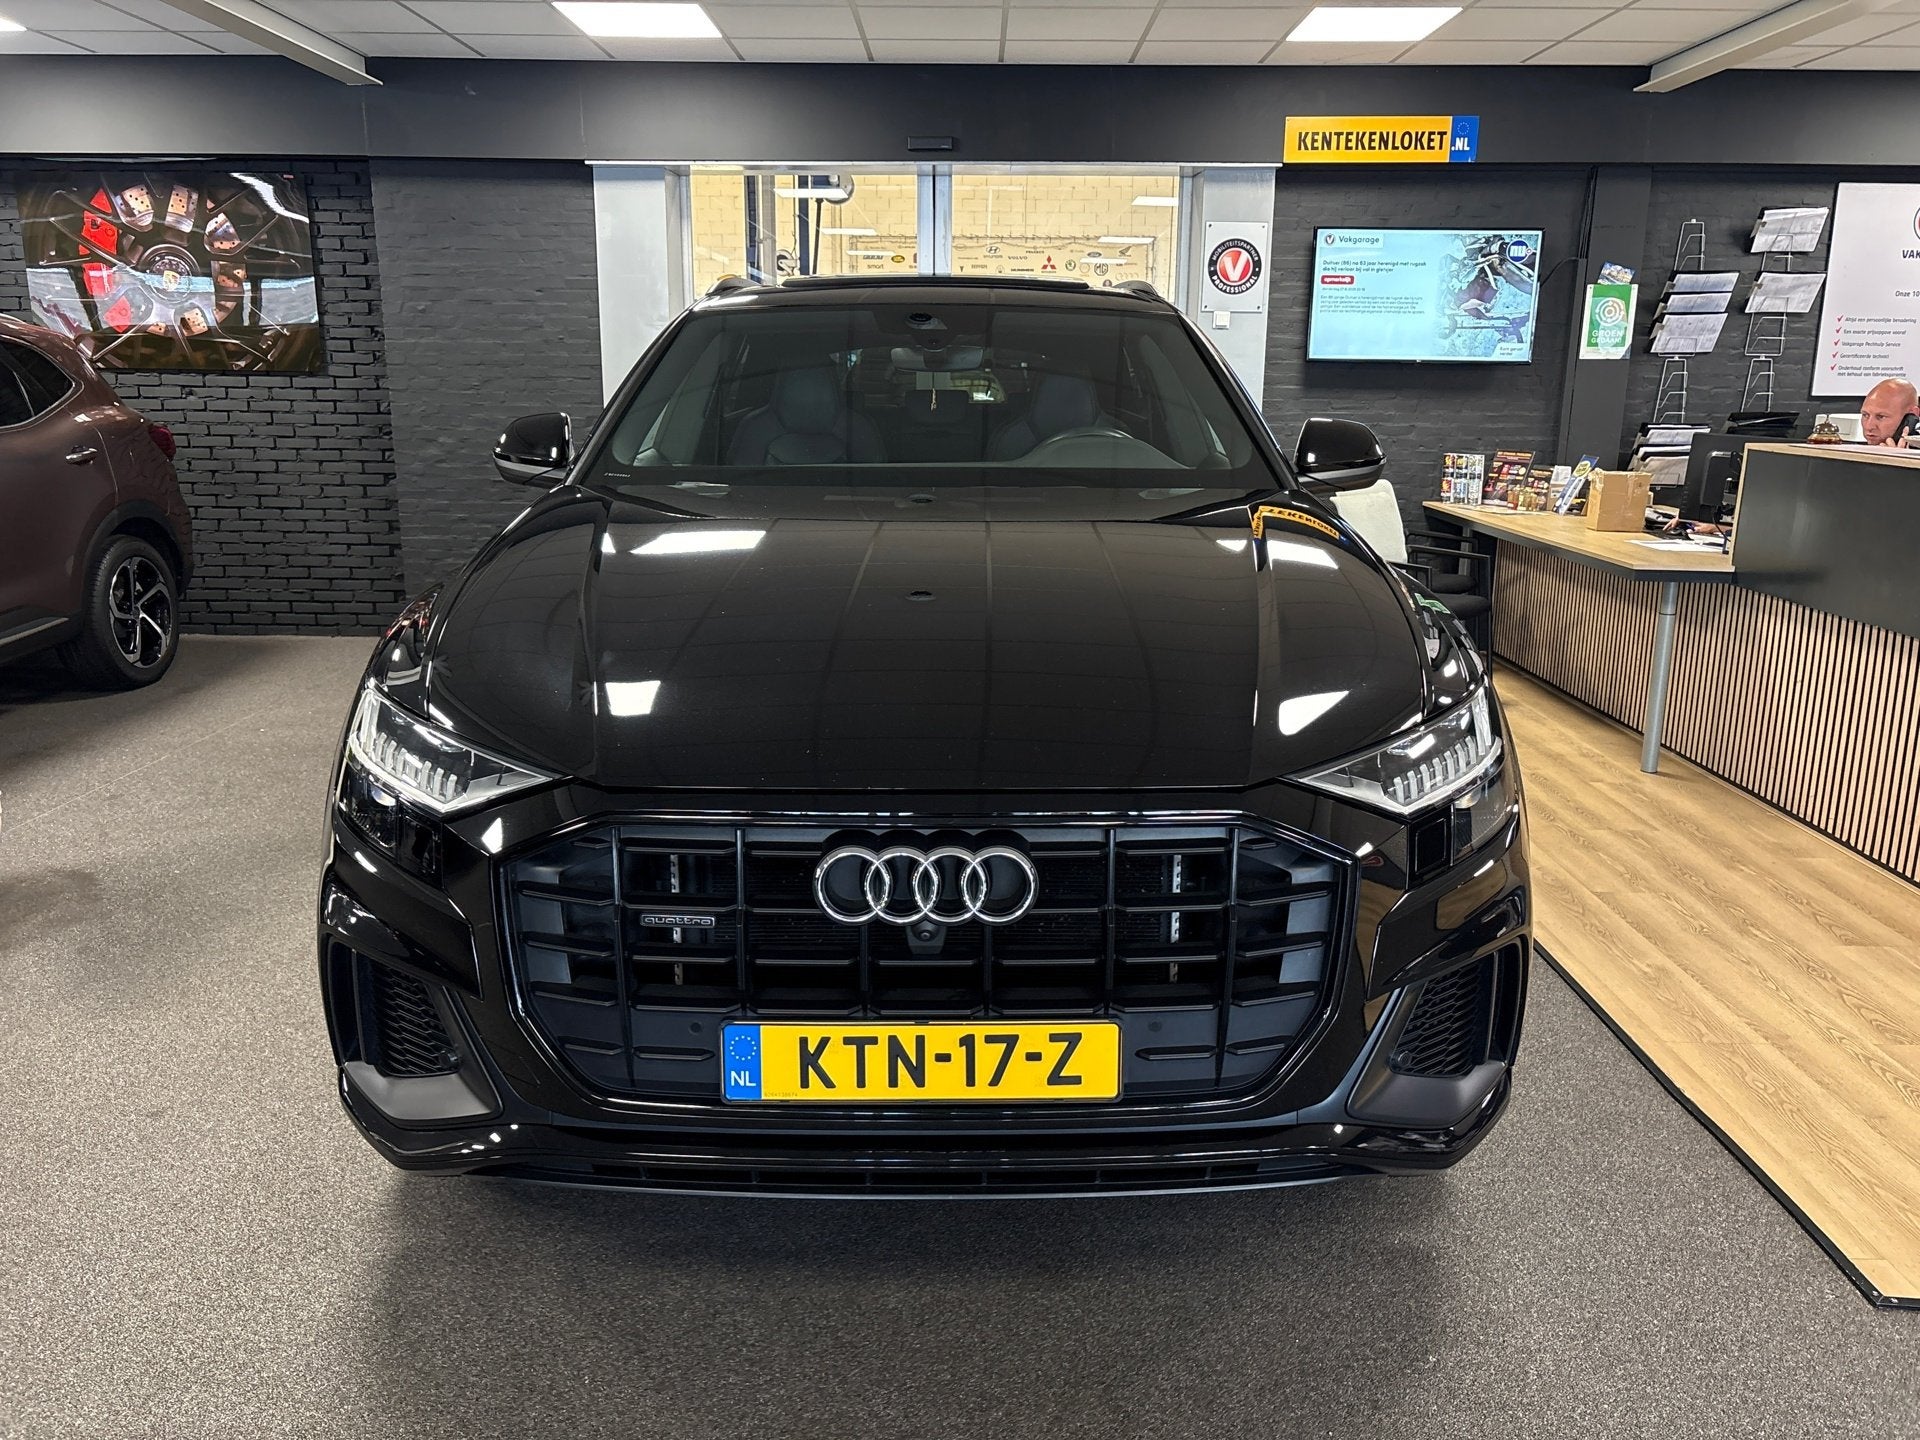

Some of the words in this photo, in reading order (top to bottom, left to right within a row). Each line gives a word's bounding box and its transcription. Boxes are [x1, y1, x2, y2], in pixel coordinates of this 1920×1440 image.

[1298, 131, 1447, 151] KENTEKENLOKET
[1451, 137, 1470, 151] .NL
[1339, 235, 1380, 245] Vakgarage
[1212, 240, 1259, 261] MOBILITEITSPARTNER
[1211, 275, 1257, 293] PROFESSIONAL
[645, 917, 711, 925] quattro
[730, 1070, 757, 1087] NL
[798, 1032, 1083, 1089] KTN-17-Z
